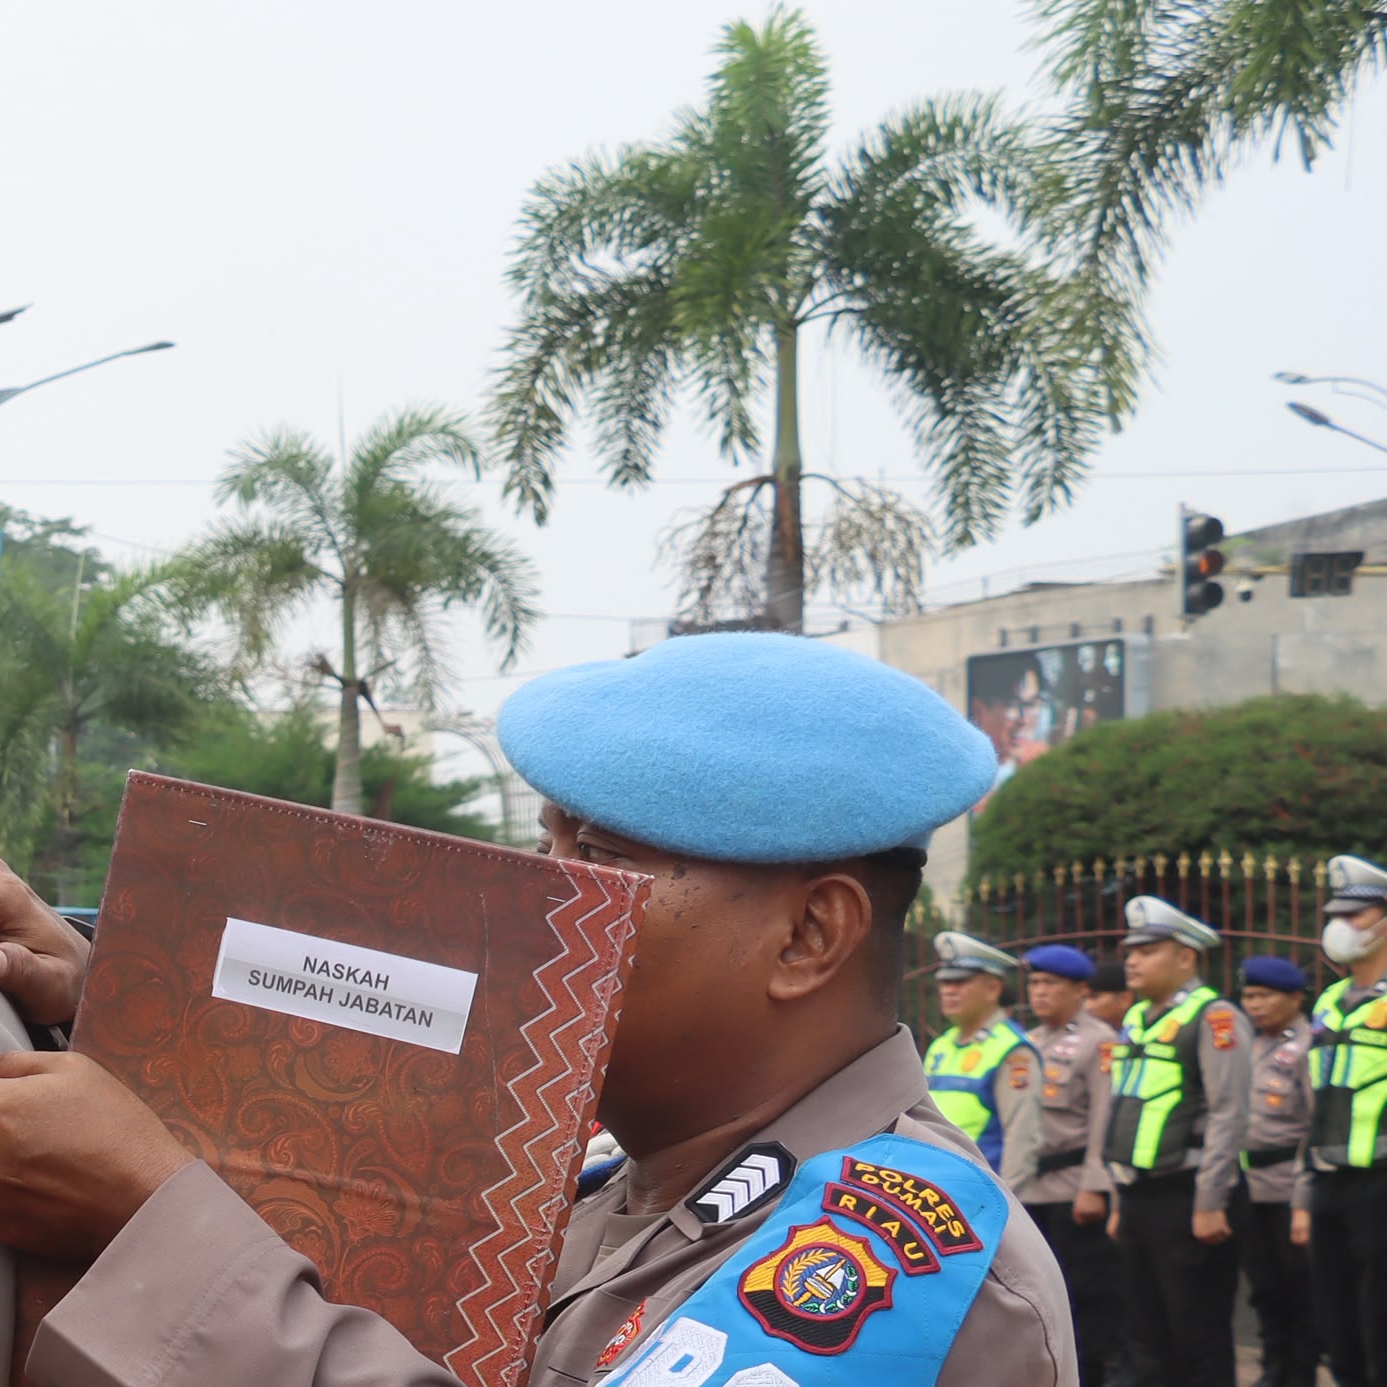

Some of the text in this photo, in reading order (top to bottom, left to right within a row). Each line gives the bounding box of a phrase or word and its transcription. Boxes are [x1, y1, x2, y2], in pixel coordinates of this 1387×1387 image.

[248, 969, 434, 1028] SUMPAH JABATAN
[302, 956, 390, 991] NASKAH
[838, 1194, 924, 1260] RIAU
[854, 1163, 966, 1237] POLRES
[861, 1174, 947, 1234] DUMAI
